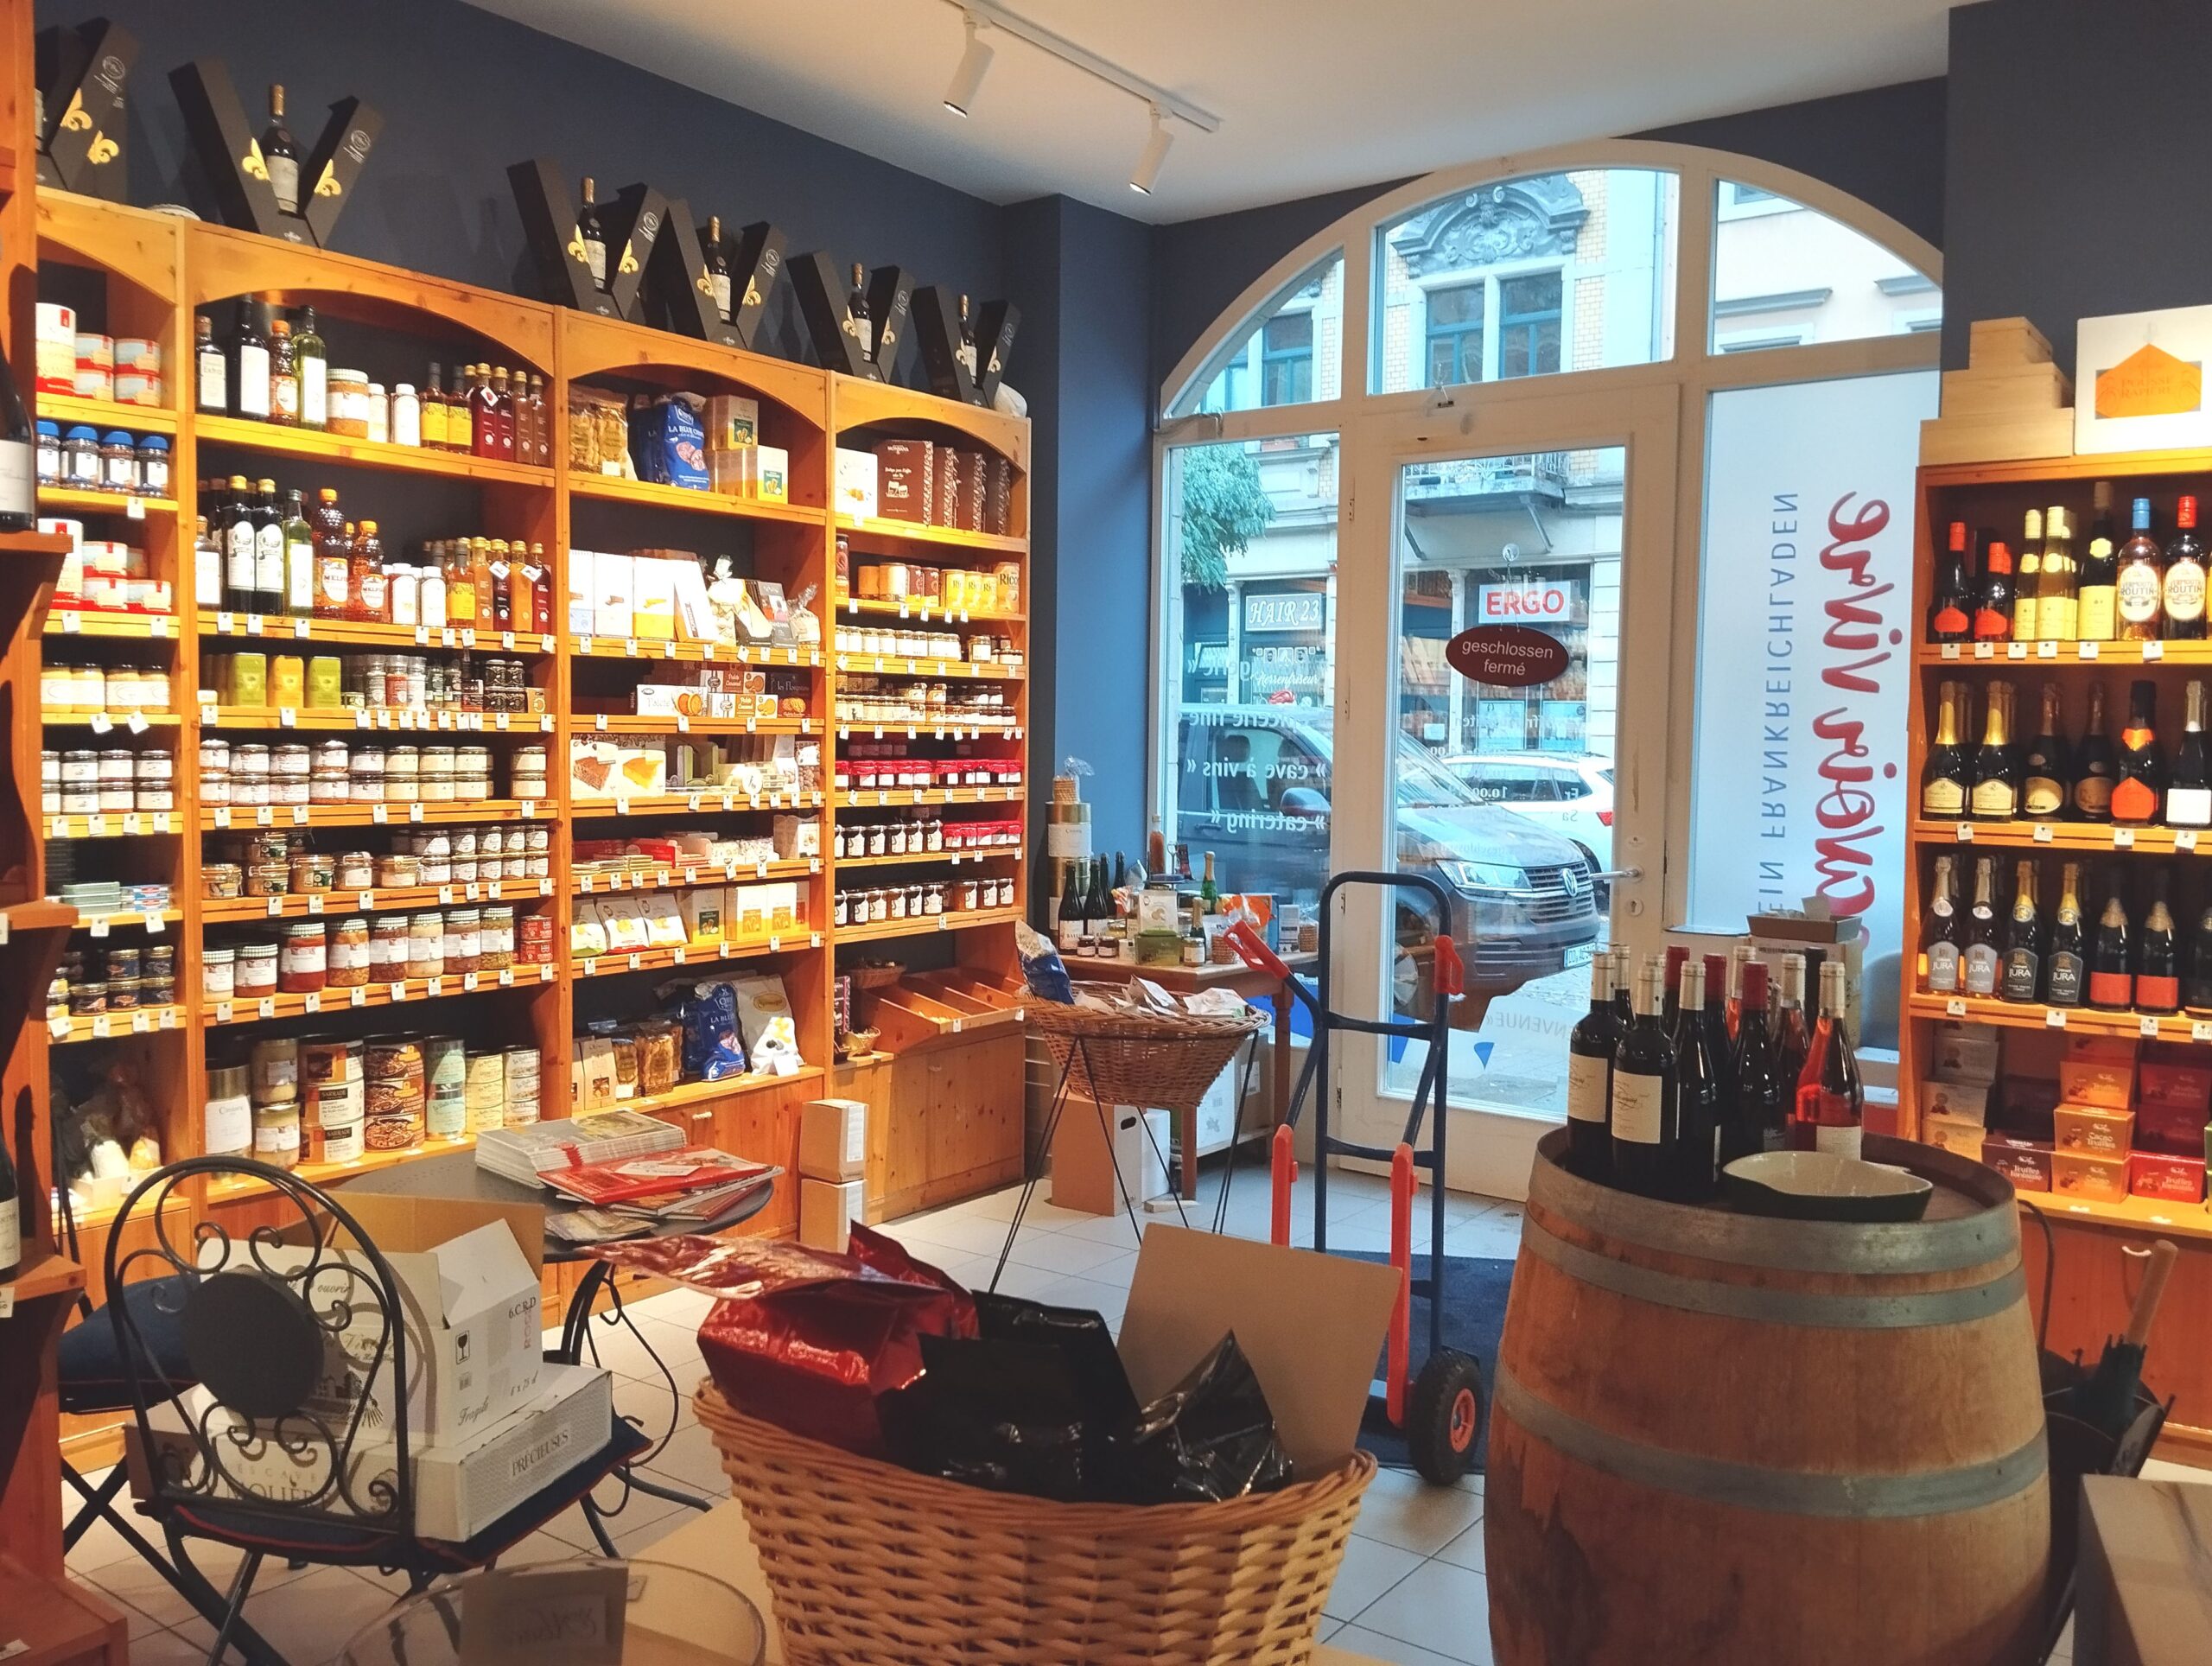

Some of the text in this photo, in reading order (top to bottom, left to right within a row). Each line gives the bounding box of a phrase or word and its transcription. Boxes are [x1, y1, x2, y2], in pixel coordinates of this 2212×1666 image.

[2120, 588, 2154, 596] ROUTIN
[2168, 585, 2202, 595] ROUTIN
[1486, 589, 1564, 615] ERGO
[1249, 599, 1320, 626] HAIR 23
[1462, 640, 1554, 659] geschlossen
[1484, 658, 1526, 676] fermé
[1932, 962, 1955, 970] JURA
[1968, 964, 1991, 973] JURA
[2009, 969, 2031, 977] JURA
[2053, 972, 2075, 982] JURA
[2088, 1133, 2113, 1141] Cacao
[2087, 1138, 2116, 1148] Truffles
[2013, 1165, 2040, 1174] Truffles
[2164, 1175, 2193, 1186] Truffles
